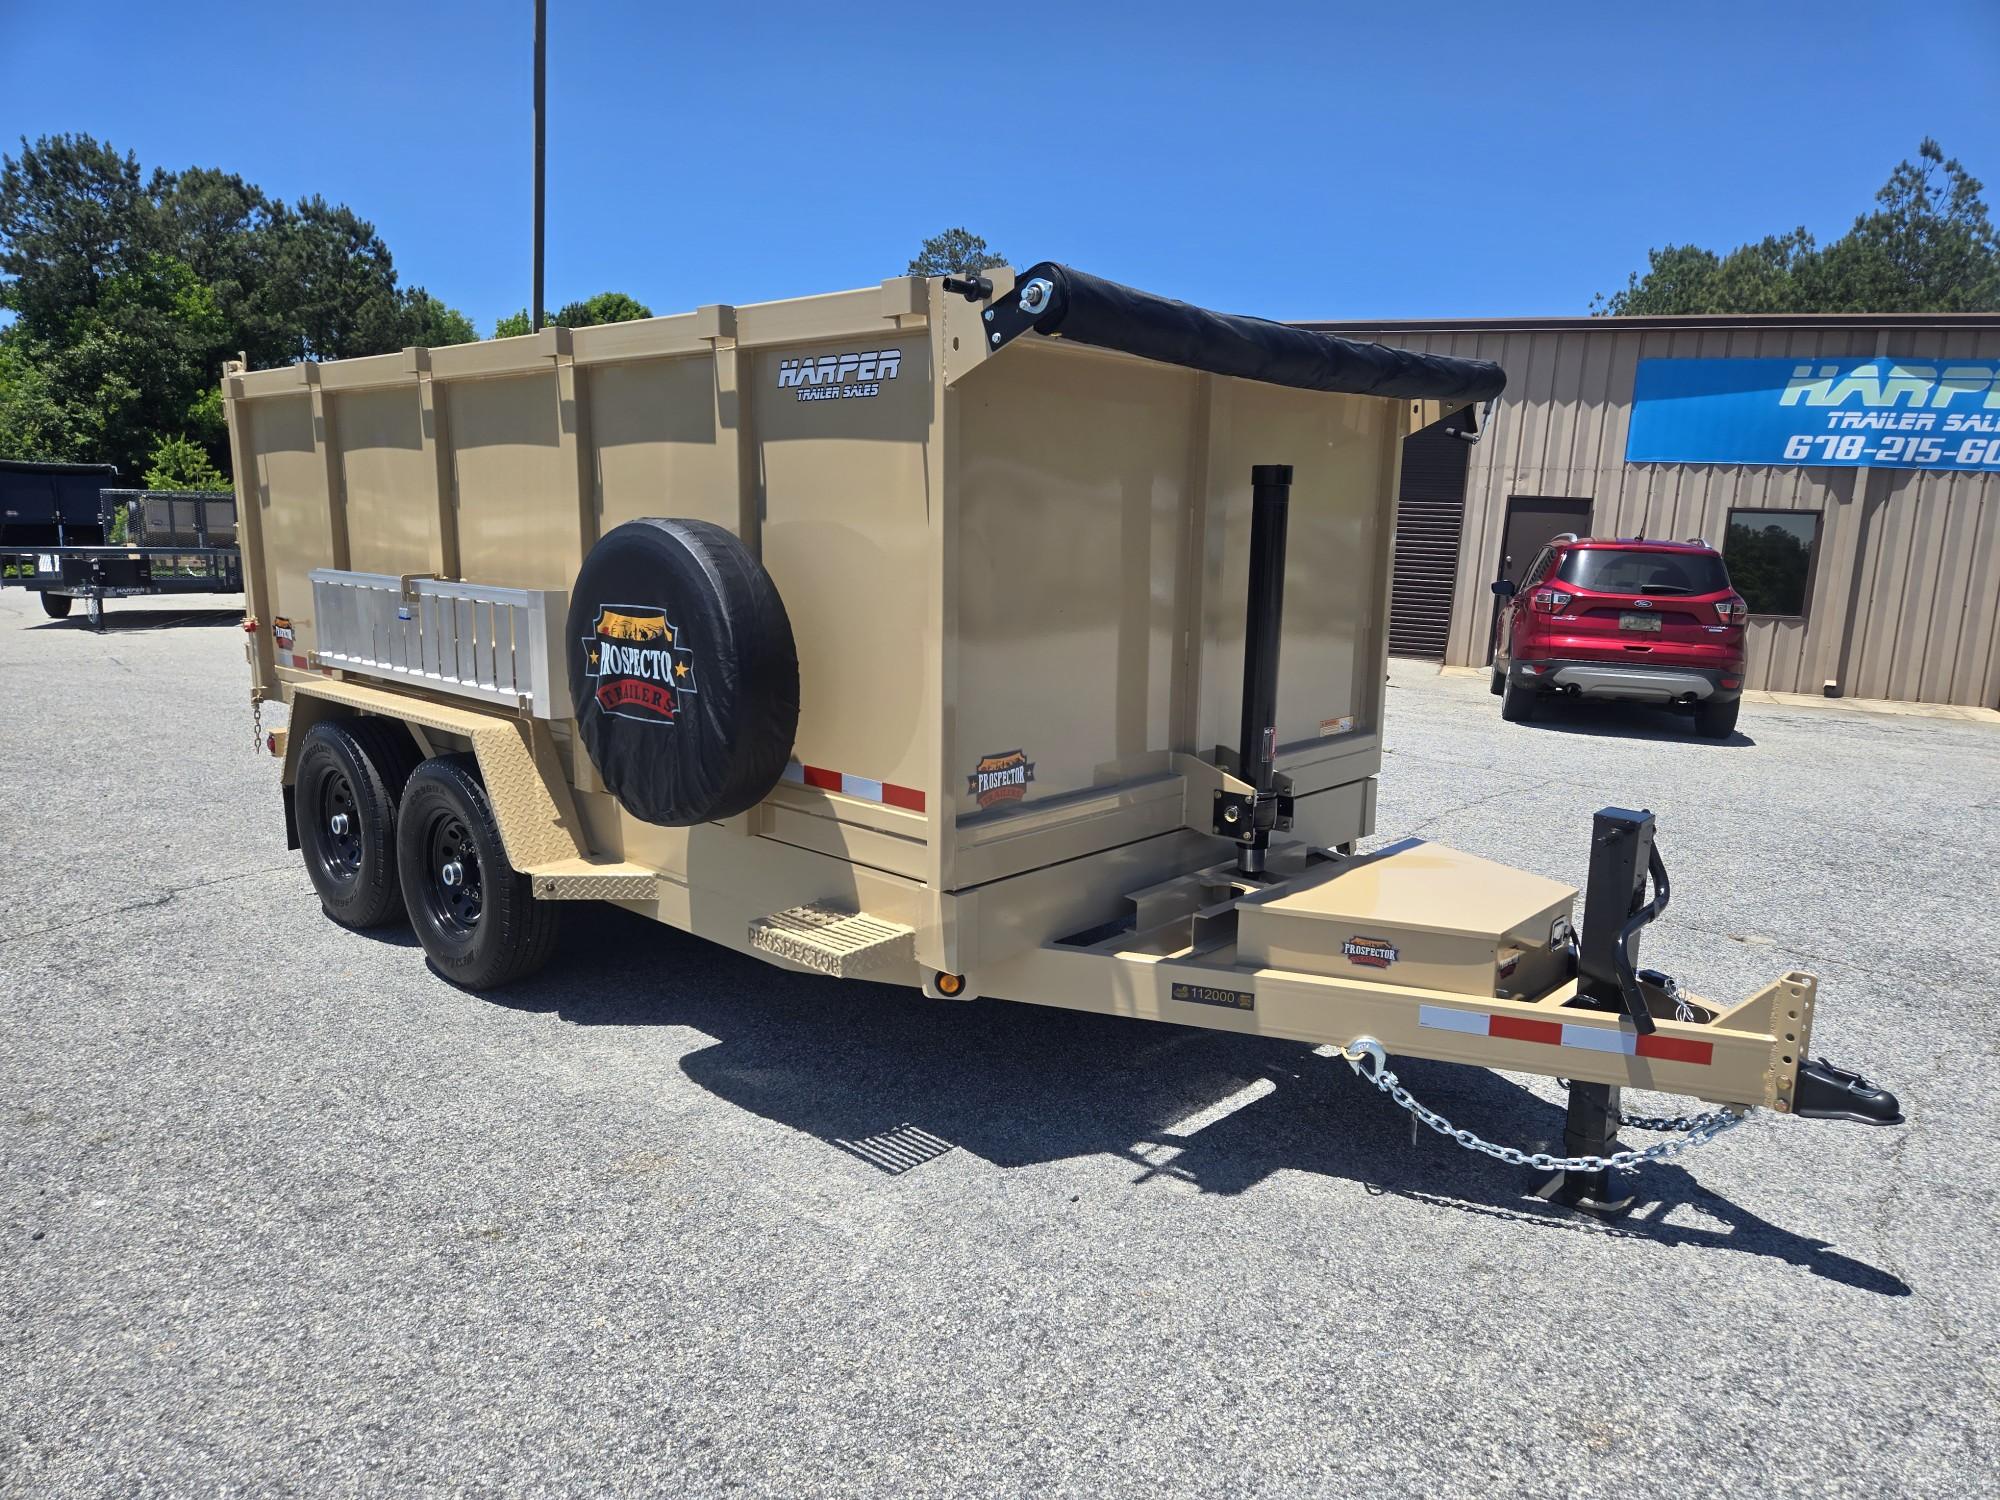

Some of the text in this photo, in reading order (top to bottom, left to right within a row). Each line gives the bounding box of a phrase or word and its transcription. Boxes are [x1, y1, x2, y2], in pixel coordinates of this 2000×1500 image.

[778, 349, 901, 388] HARPER
[797, 383, 879, 401] TRAILER SALES
[1827, 411, 2000, 432] TRAILER SAL
[978, 765, 1025, 793] PROSPECTOR
[747, 927, 841, 976] PROSPECTOR
[1344, 943, 1396, 960] PROSPECTOR
[1191, 986, 1235, 1003] 112000
